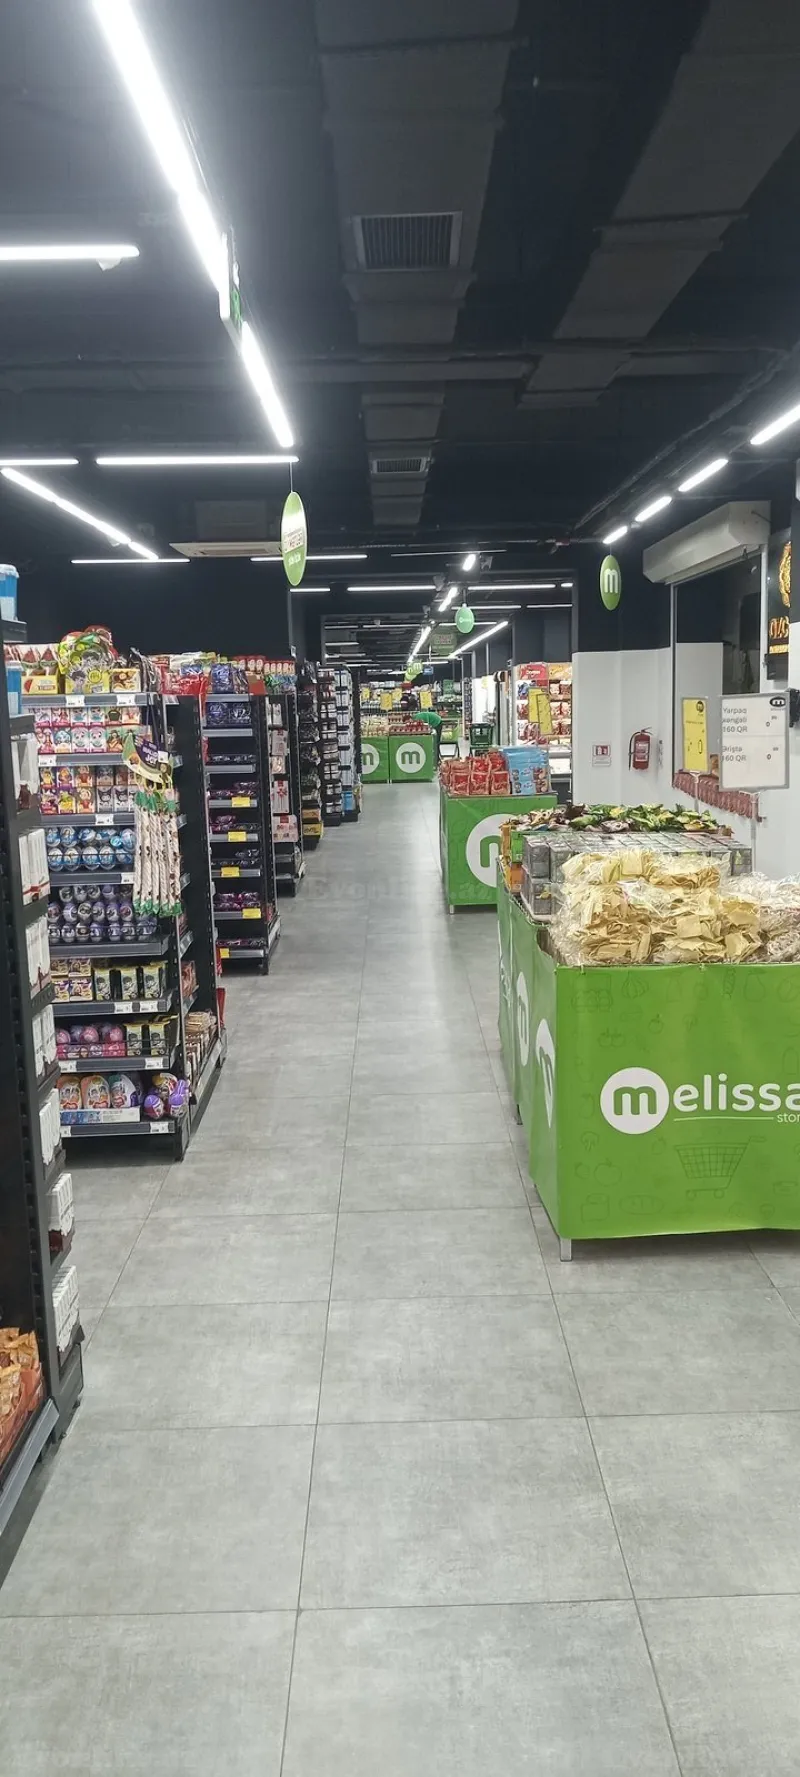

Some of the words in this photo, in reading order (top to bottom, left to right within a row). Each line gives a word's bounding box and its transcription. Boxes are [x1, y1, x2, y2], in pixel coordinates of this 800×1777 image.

[604, 568, 618, 593] m
[401, 751, 420, 764] m
[610, 1072, 800, 1119] melissa
